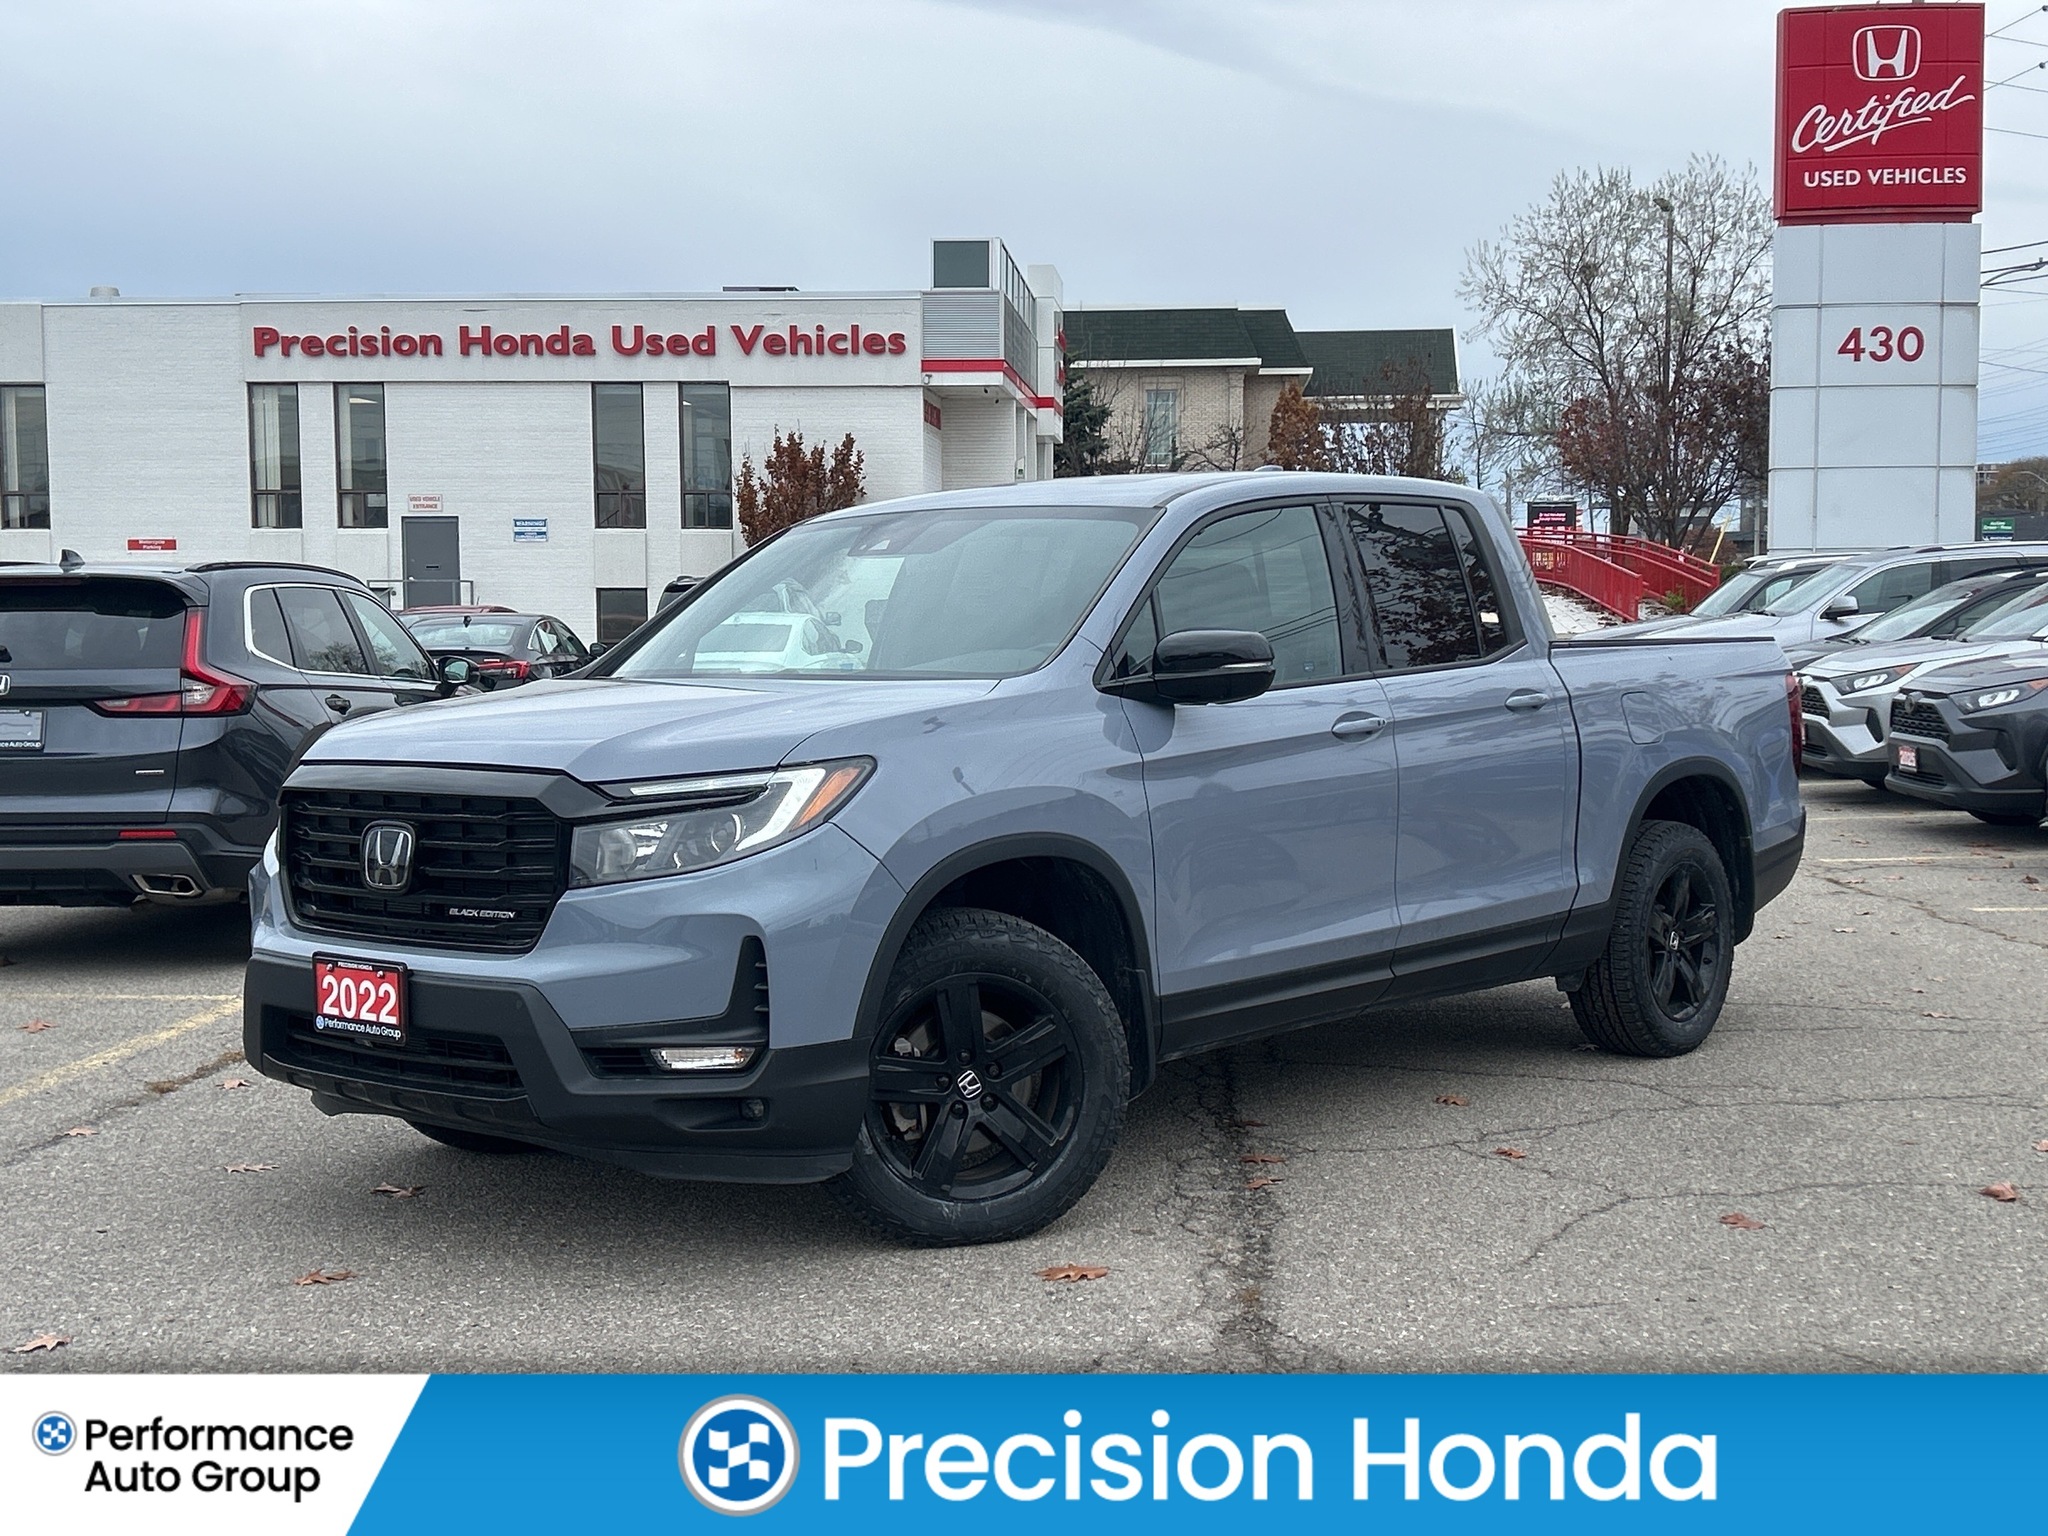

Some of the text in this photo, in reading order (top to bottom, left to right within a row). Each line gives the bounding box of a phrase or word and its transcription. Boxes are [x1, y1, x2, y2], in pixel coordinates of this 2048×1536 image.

[1791, 74, 1976, 153] Certified
[1804, 167, 1967, 188] USED VEHICLES
[253, 324, 906, 357] Precision Honda Used Vehicles
[1838, 326, 1924, 362] 430
[449, 907, 516, 919] BLACK EDITION
[322, 974, 398, 1026] 2022
[324, 1017, 401, 1041] Performance Auto Group
